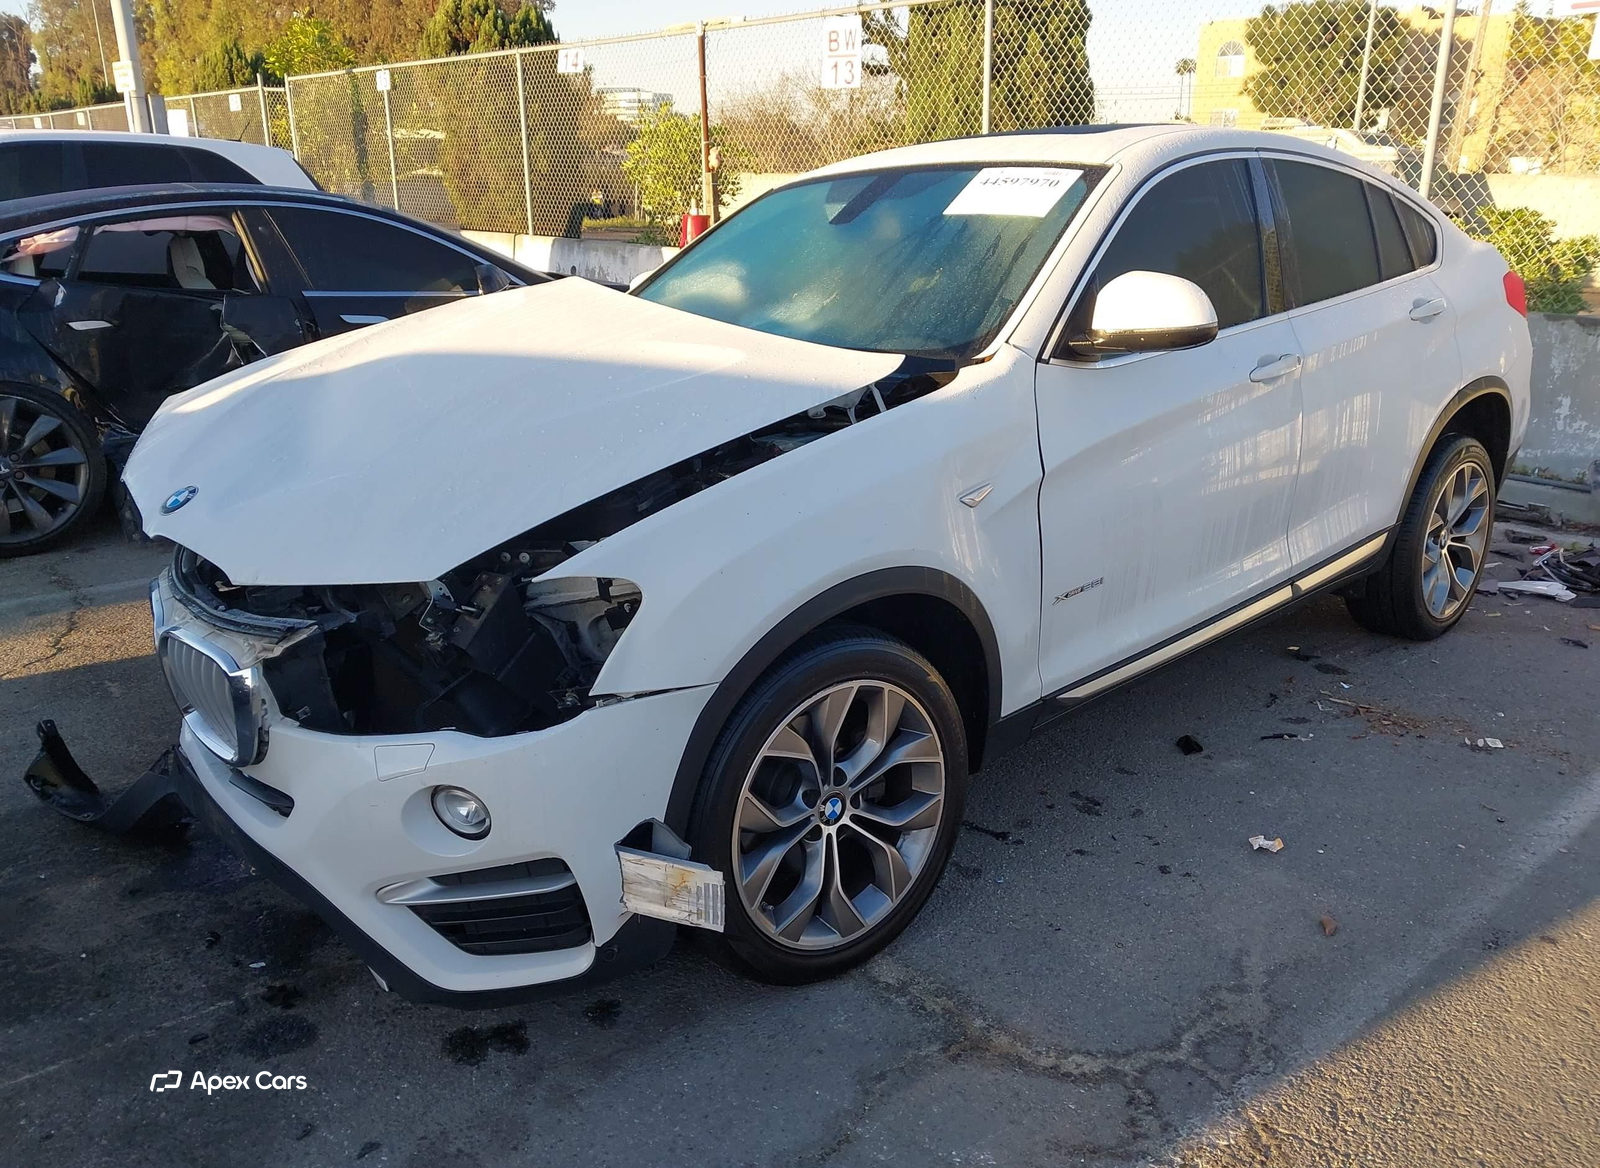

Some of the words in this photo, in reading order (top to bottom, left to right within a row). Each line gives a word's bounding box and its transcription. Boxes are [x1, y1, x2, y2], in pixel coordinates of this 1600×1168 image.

[829, 28, 857, 52] BW
[564, 50, 579, 71] 14
[831, 60, 855, 85] 13
